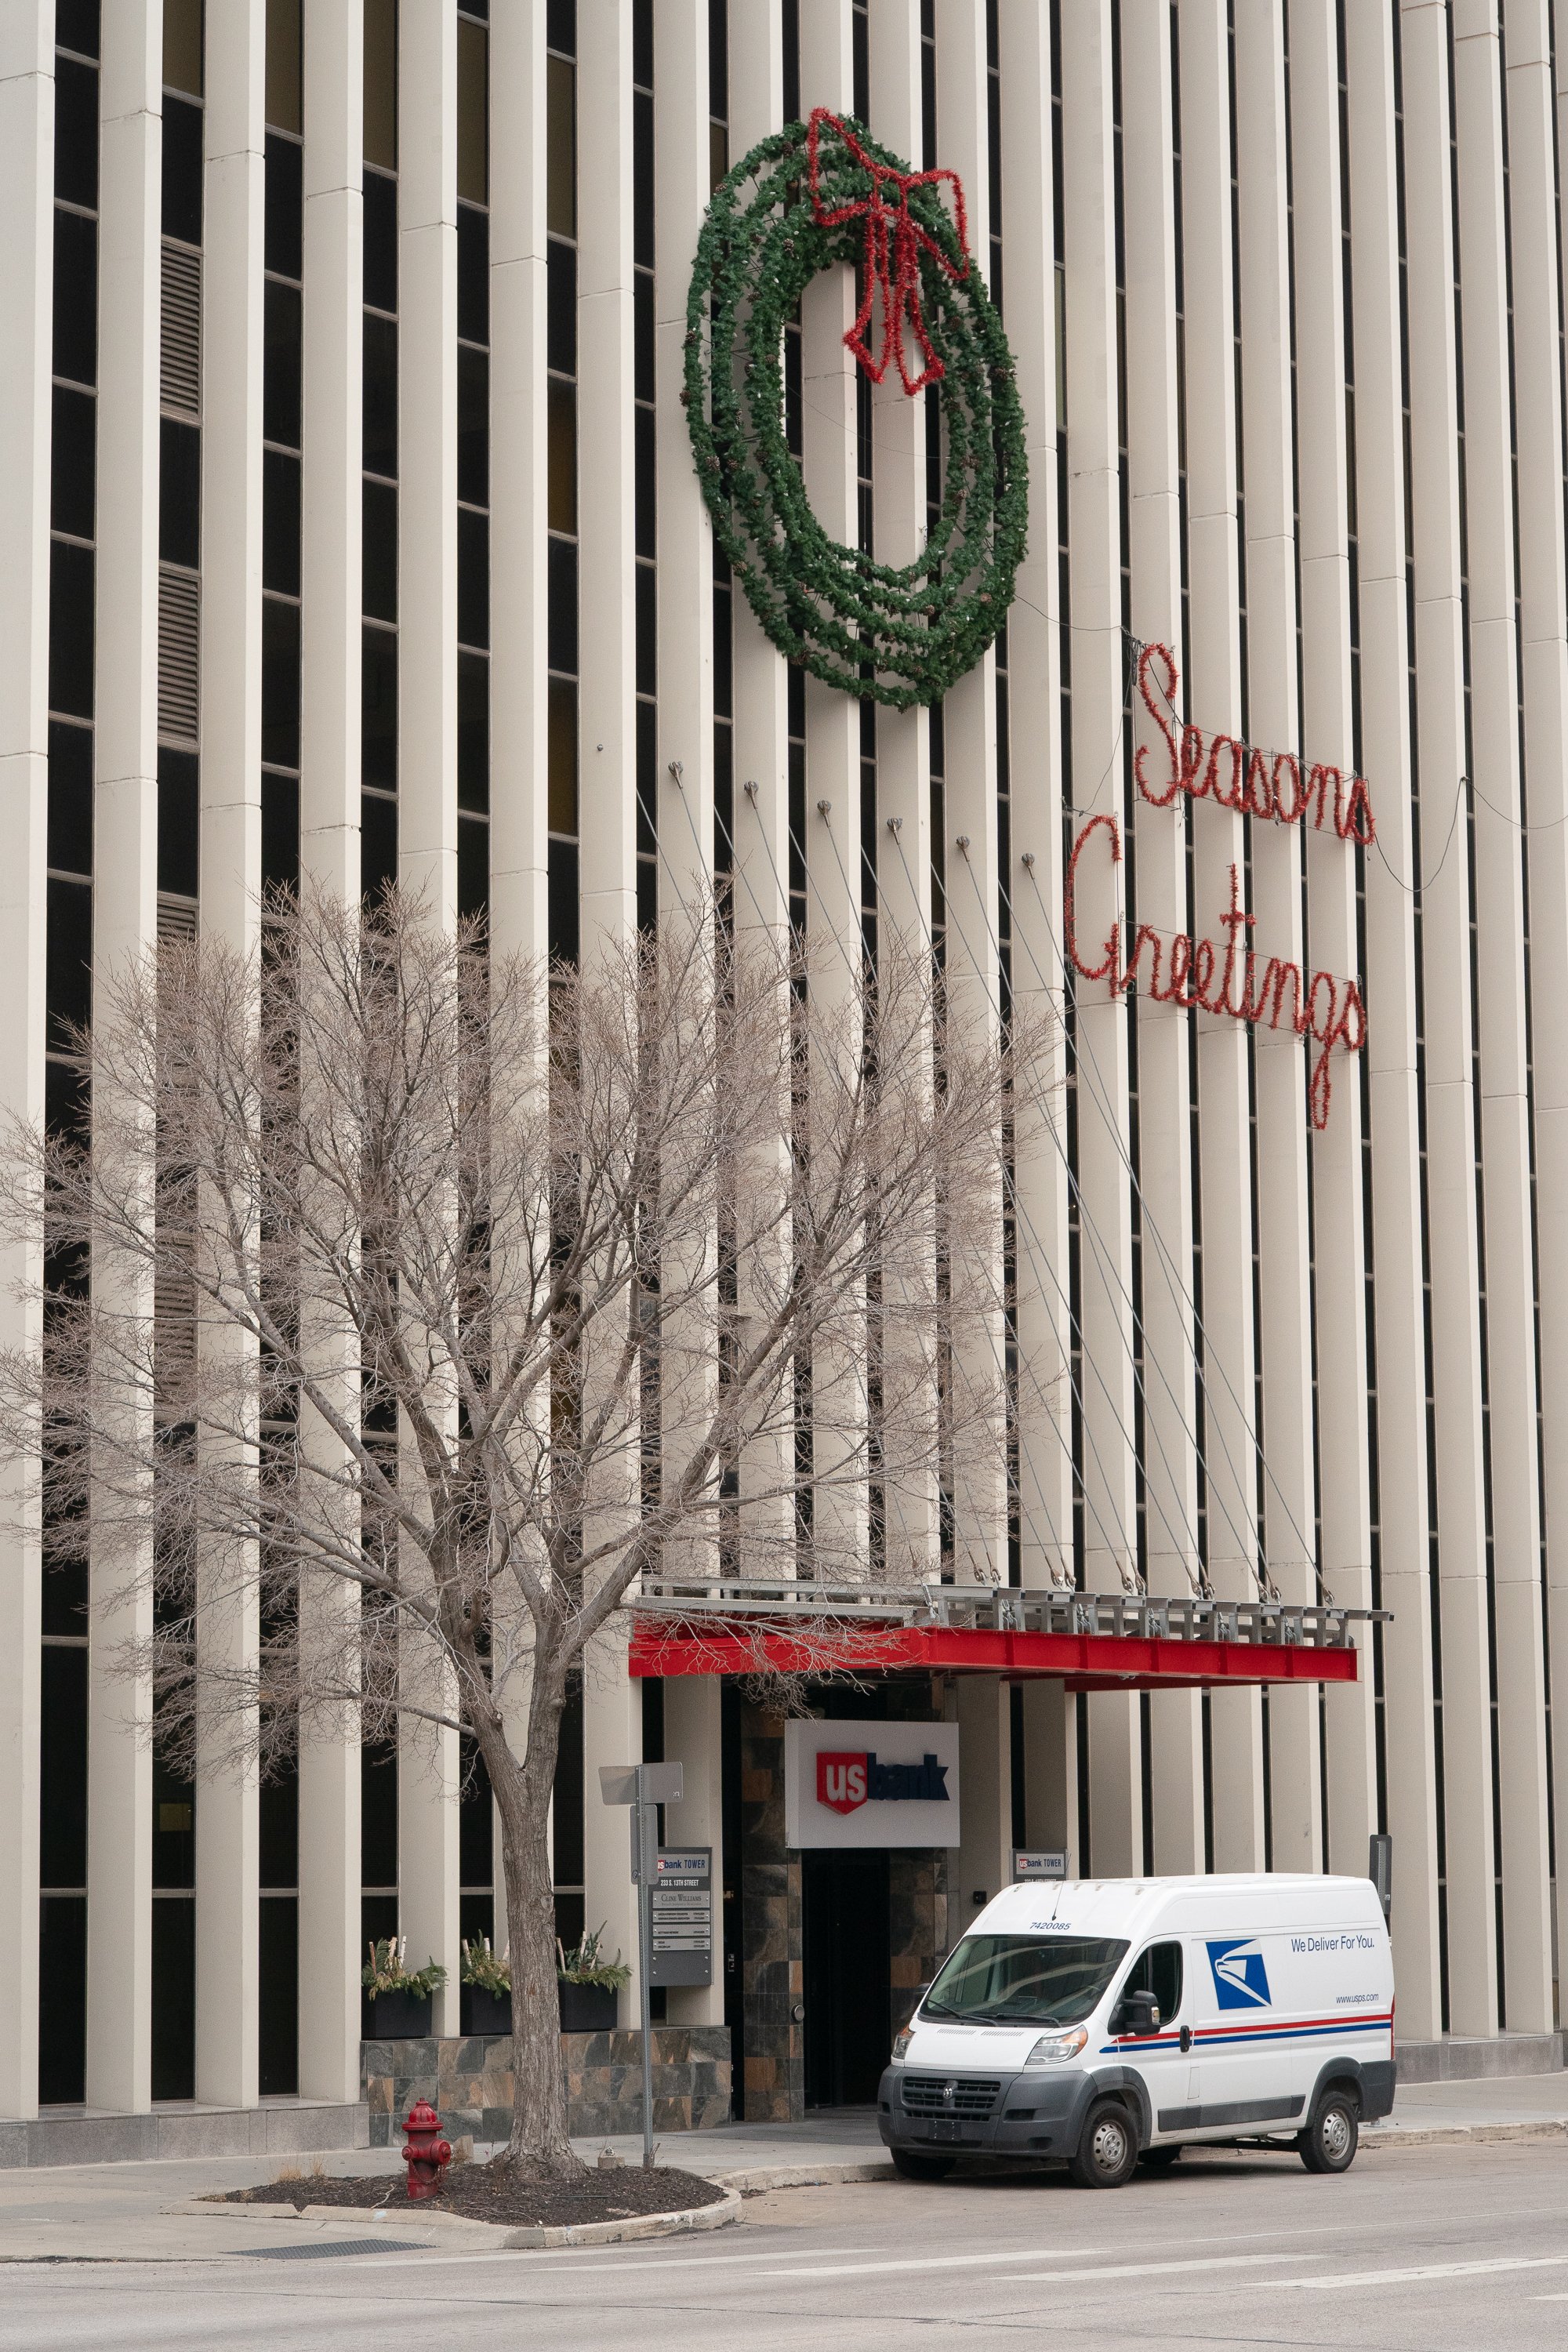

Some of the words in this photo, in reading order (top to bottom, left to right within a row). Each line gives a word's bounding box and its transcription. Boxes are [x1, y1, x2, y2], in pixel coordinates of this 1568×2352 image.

[1134, 643, 1375, 845] Seasons
[1065, 814, 1366, 1130] Greetings
[684, 1860, 705, 1868] TOWER
[1044, 1859, 1062, 1868] TOWER
[1290, 1938, 1306, 1952] We
[1308, 1936, 1339, 1951] Deliver
[1341, 1936, 1356, 1949] For
[1356, 1935, 1374, 1948] You.
[1336, 1993, 1379, 2004] www.usps.com
